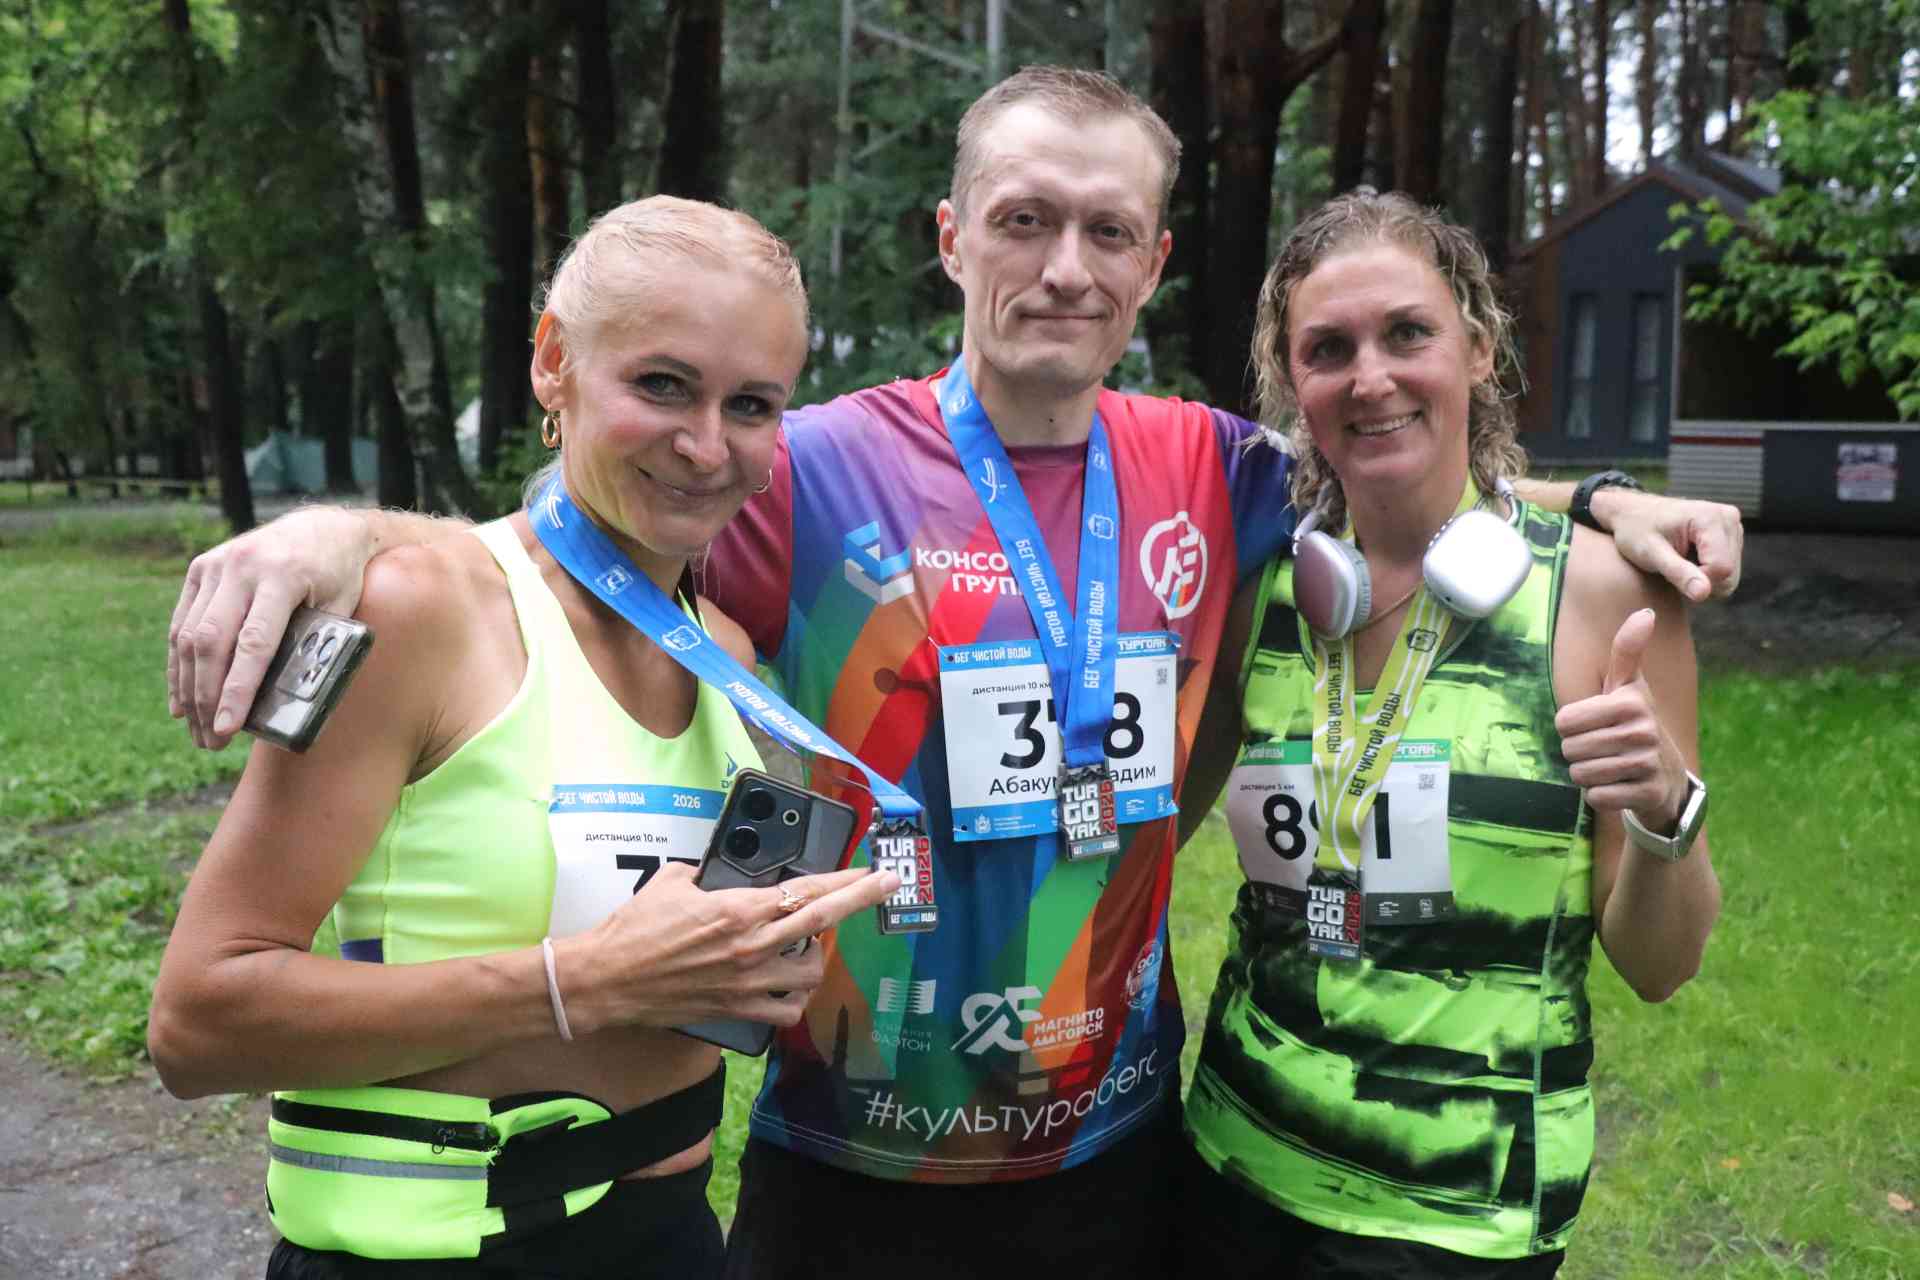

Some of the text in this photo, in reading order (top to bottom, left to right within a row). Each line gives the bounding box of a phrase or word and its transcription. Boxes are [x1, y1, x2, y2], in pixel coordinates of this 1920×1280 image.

[915, 547, 1009, 572] КОНСО
[952, 572, 1023, 595] ГРУП
[1015, 538, 1069, 648] БЕГ ЧИСТОЙ ВОДЫ
[1084, 580, 1104, 689] БЕГ ЧИСТОЙ ВОДЫ
[954, 646, 1032, 664] БЕГ ЧИСТОЙ ВОДЫ
[725, 681, 769, 710] ВОДЫ
[972, 683, 1026, 696] дистанция
[1027, 681, 1038, 690] 10
[1326, 652, 1344, 753] БЕГ ЧИСТОЙ ВОДЫ
[761, 708, 812, 743] ЧИСТОЙ
[998, 691, 1144, 770] 38
[1348, 692, 1402, 797] БЕГ ЧИСТОЙ ВОДЫ
[989, 766, 1156, 796] Абаку адим
[1062, 783, 1098, 802] TUR
[579, 789, 617, 805] ЧИСТОЙ
[618, 791, 647, 806] ВОДЫ
[672, 793, 701, 809] 2026
[1063, 800, 1100, 825] GO
[585, 832, 668, 844] дистанция 10 км
[1064, 821, 1101, 840] YAK
[1263, 792, 1392, 860] 81
[877, 838, 915, 857] TUR
[1308, 885, 1345, 904] TUR
[1307, 901, 1345, 925] GO
[1307, 921, 1344, 941] YAK
[1034, 1007, 1104, 1035] МАГНИТО
[1057, 1020, 1104, 1042] ГОРСК
